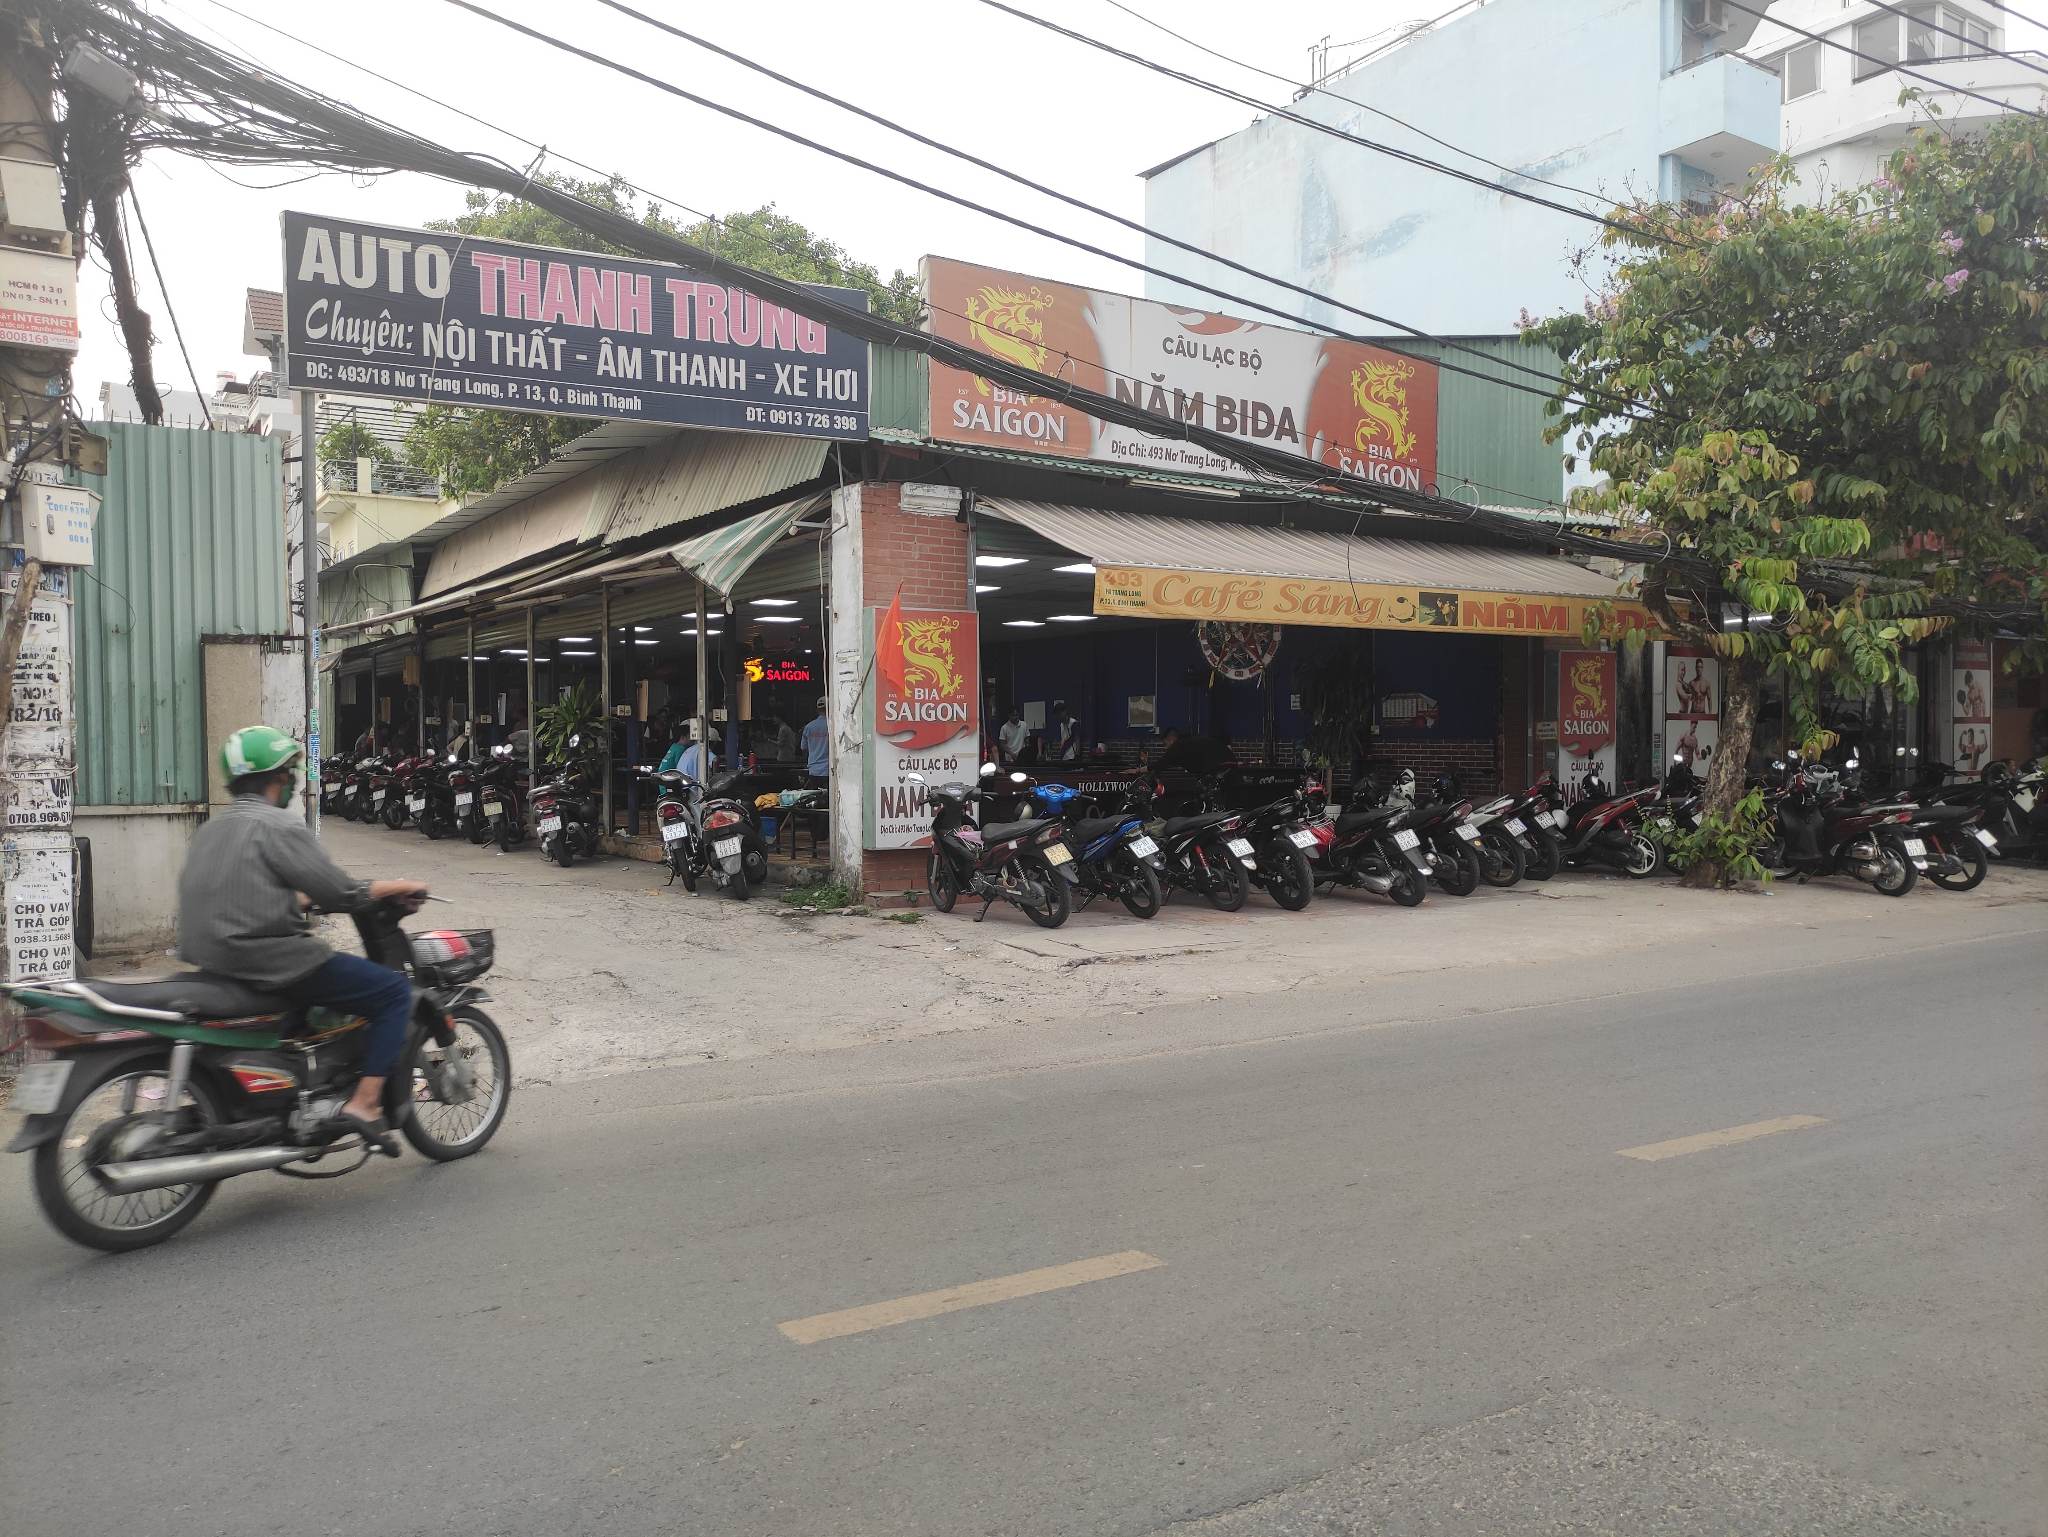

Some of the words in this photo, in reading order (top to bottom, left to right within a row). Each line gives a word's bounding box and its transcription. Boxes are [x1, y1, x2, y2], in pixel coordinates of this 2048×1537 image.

[298, 227, 451, 299] AUTO
[472, 251, 652, 335] THANH
[665, 278, 827, 355] TRUNG
[12, 312, 74, 328] INTERNET
[305, 298, 415, 356] Chuyên:
[423, 319, 476, 368] NỘI
[485, 326, 567, 372] THẤT
[596, 336, 643, 381] ÂM
[651, 349, 747, 392] THANH
[774, 362, 808, 397] XE
[816, 367, 858, 402] HƠI
[1162, 335, 1198, 359] CÂU
[1202, 347, 1235, 369] LẠC
[1239, 349, 1263, 376] BỘ
[306, 361, 333, 380] ĐC:
[338, 365, 391, 386] 493/18
[395, 371, 416, 388] Nơ
[420, 374, 461, 395] Trang
[465, 378, 504, 399] Long,
[508, 383, 520, 399] P.
[524, 385, 545, 403] 13,
[550, 387, 563, 404] Q.
[567, 388, 598, 407] Bình
[602, 392, 642, 412] Thạnh
[993, 387, 1028, 406] BIA
[746, 406, 766, 423] ĐT:
[769, 409, 802, 426] 0913
[806, 412, 830, 429] 726
[833, 415, 857, 431] 398
[1115, 372, 1204, 427] NĂM
[1215, 394, 1300, 444] BIDA
[953, 399, 1065, 442] SAIGON
[1111, 440, 1127, 460] Địa
[1147, 446, 1163, 460] 493
[1165, 448, 1179, 462] Nơ
[1180, 450, 1204, 469] Trang
[1206, 454, 1228, 471] Long,
[1368, 443, 1393, 460] BIA
[1340, 456, 1420, 491] SAIGON
[1152, 574, 1266, 615] Café
[1273, 582, 1385, 624] Sáng
[1462, 596, 1569, 632] NĂM
[766, 669, 810, 681] SAIGON
[914, 687, 940, 700] BIA
[885, 700, 968, 722] SAIGON
[1580, 709, 1595, 719] BIA
[1564, 719, 1610, 735] SAIGON
[898, 754, 920, 771] CÂU
[921, 758, 941, 775] LẠC
[943, 754, 958, 775] BỘ
[880, 776, 925, 818] NĂM
[15, 904, 46, 915] CHO
[50, 902, 70, 913] VAY
[15, 914, 45, 929] TRẢ
[50, 914, 70, 927] GÓP
[19, 948, 49, 959] CHO
[54, 946, 72, 957] VAY
[19, 958, 48, 974] TRẢ
[53, 957, 72, 970] GÓP
